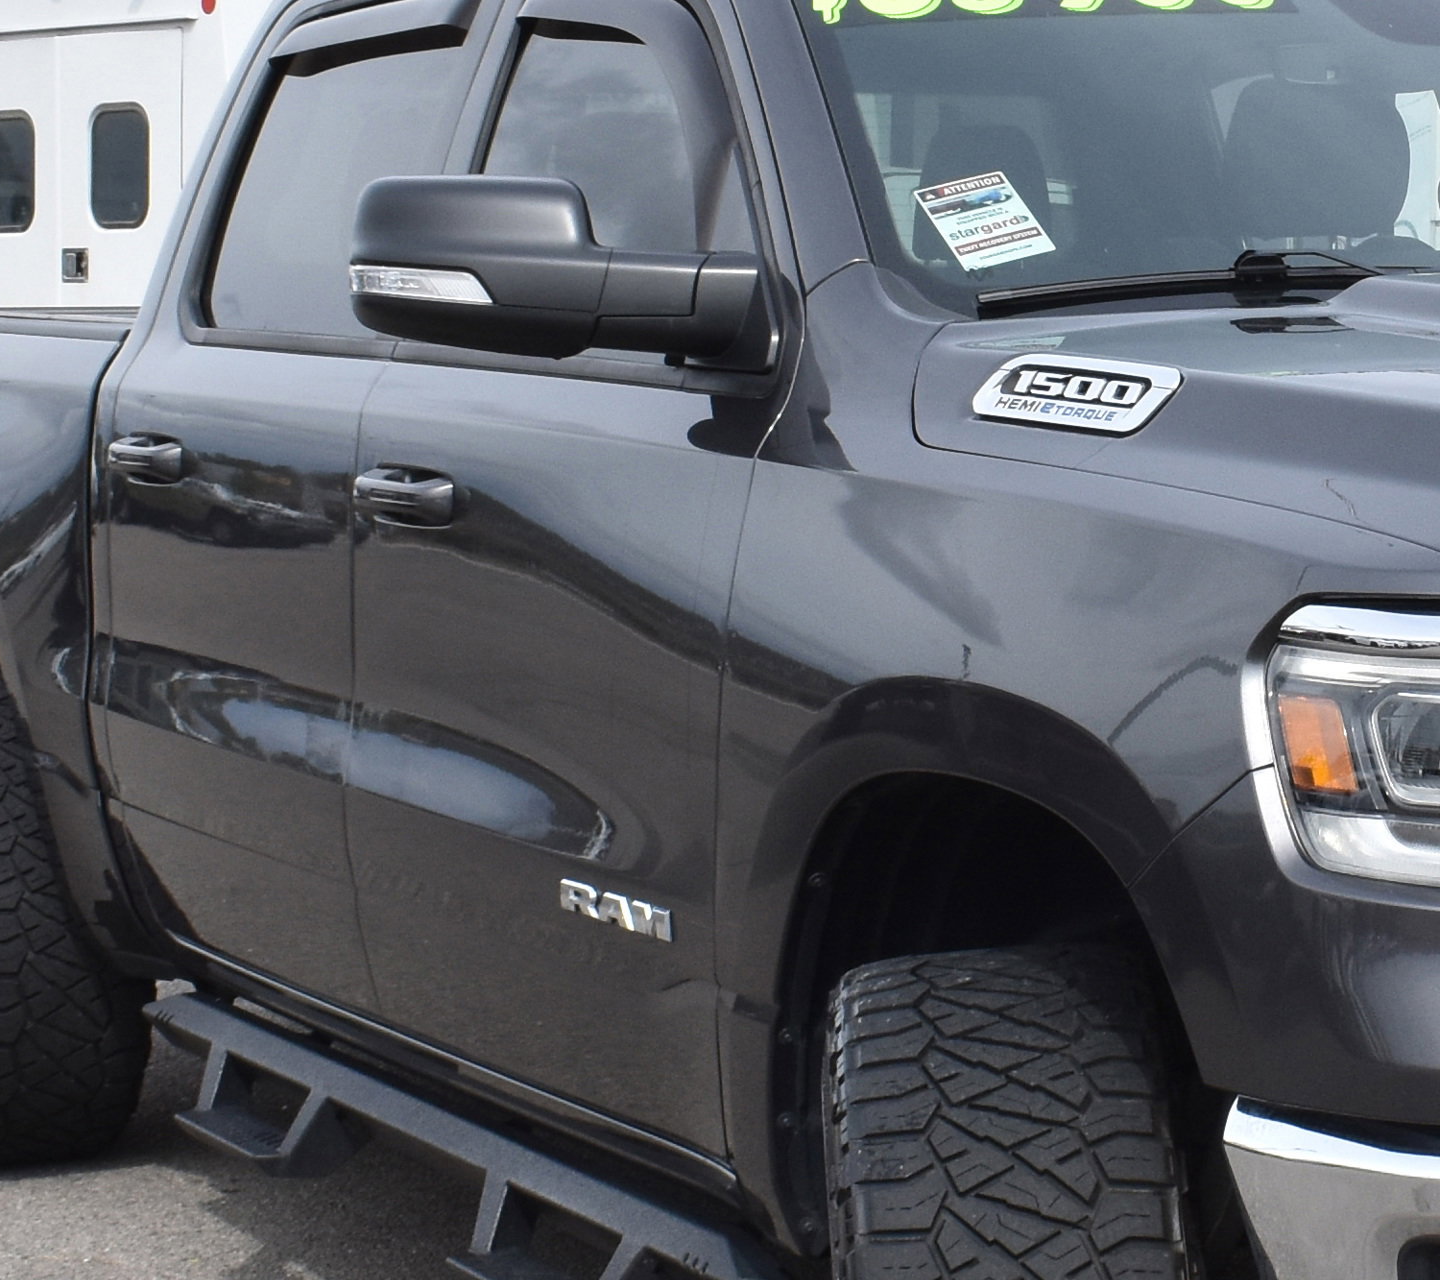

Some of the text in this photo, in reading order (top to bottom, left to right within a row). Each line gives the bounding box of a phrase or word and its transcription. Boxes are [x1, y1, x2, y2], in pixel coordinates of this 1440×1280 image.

[943, 175, 1001, 196] ATTENTION
[949, 214, 1021, 241] stargard
[1013, 370, 1146, 406] 1500
[994, 396, 1038, 413] HEMI
[560, 878, 673, 943] RAM
